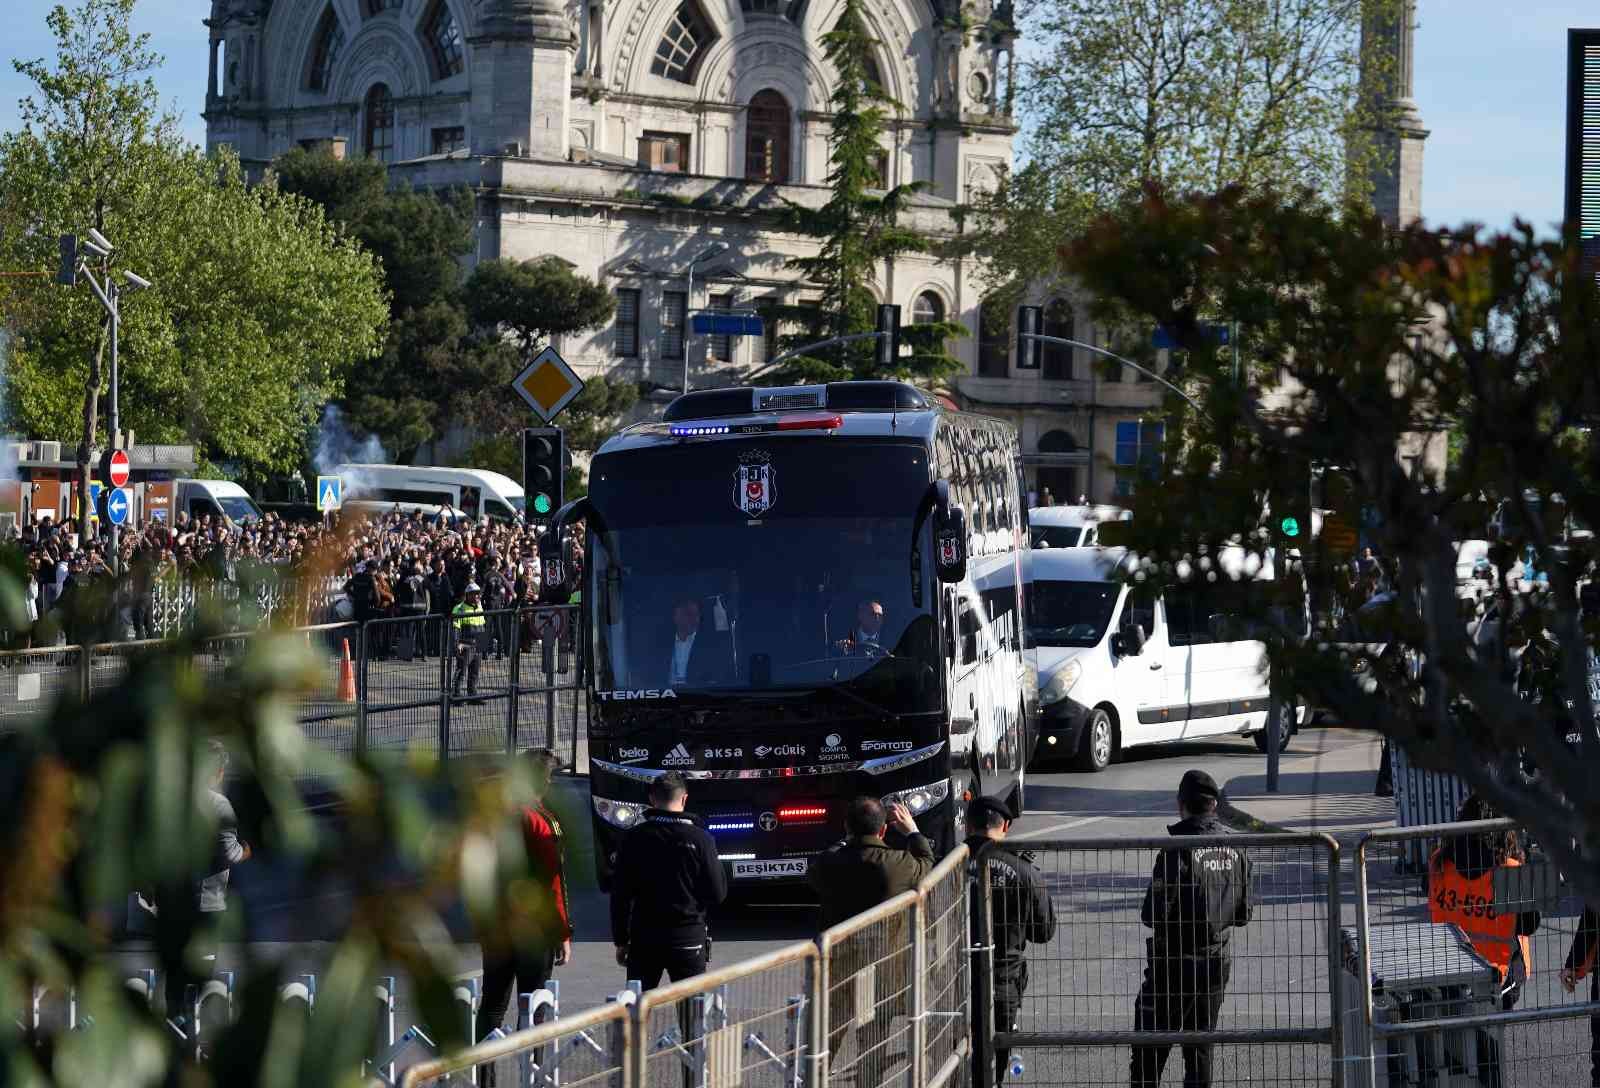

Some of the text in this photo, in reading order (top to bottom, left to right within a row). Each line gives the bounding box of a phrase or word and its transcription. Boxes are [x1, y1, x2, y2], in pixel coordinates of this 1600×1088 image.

[597, 688, 677, 701] TEMSA
[619, 746, 649, 759] beko
[704, 747, 743, 758] aksa
[661, 756, 696, 767] adidas
[736, 862, 804, 875] BEŞİKTAŞ
